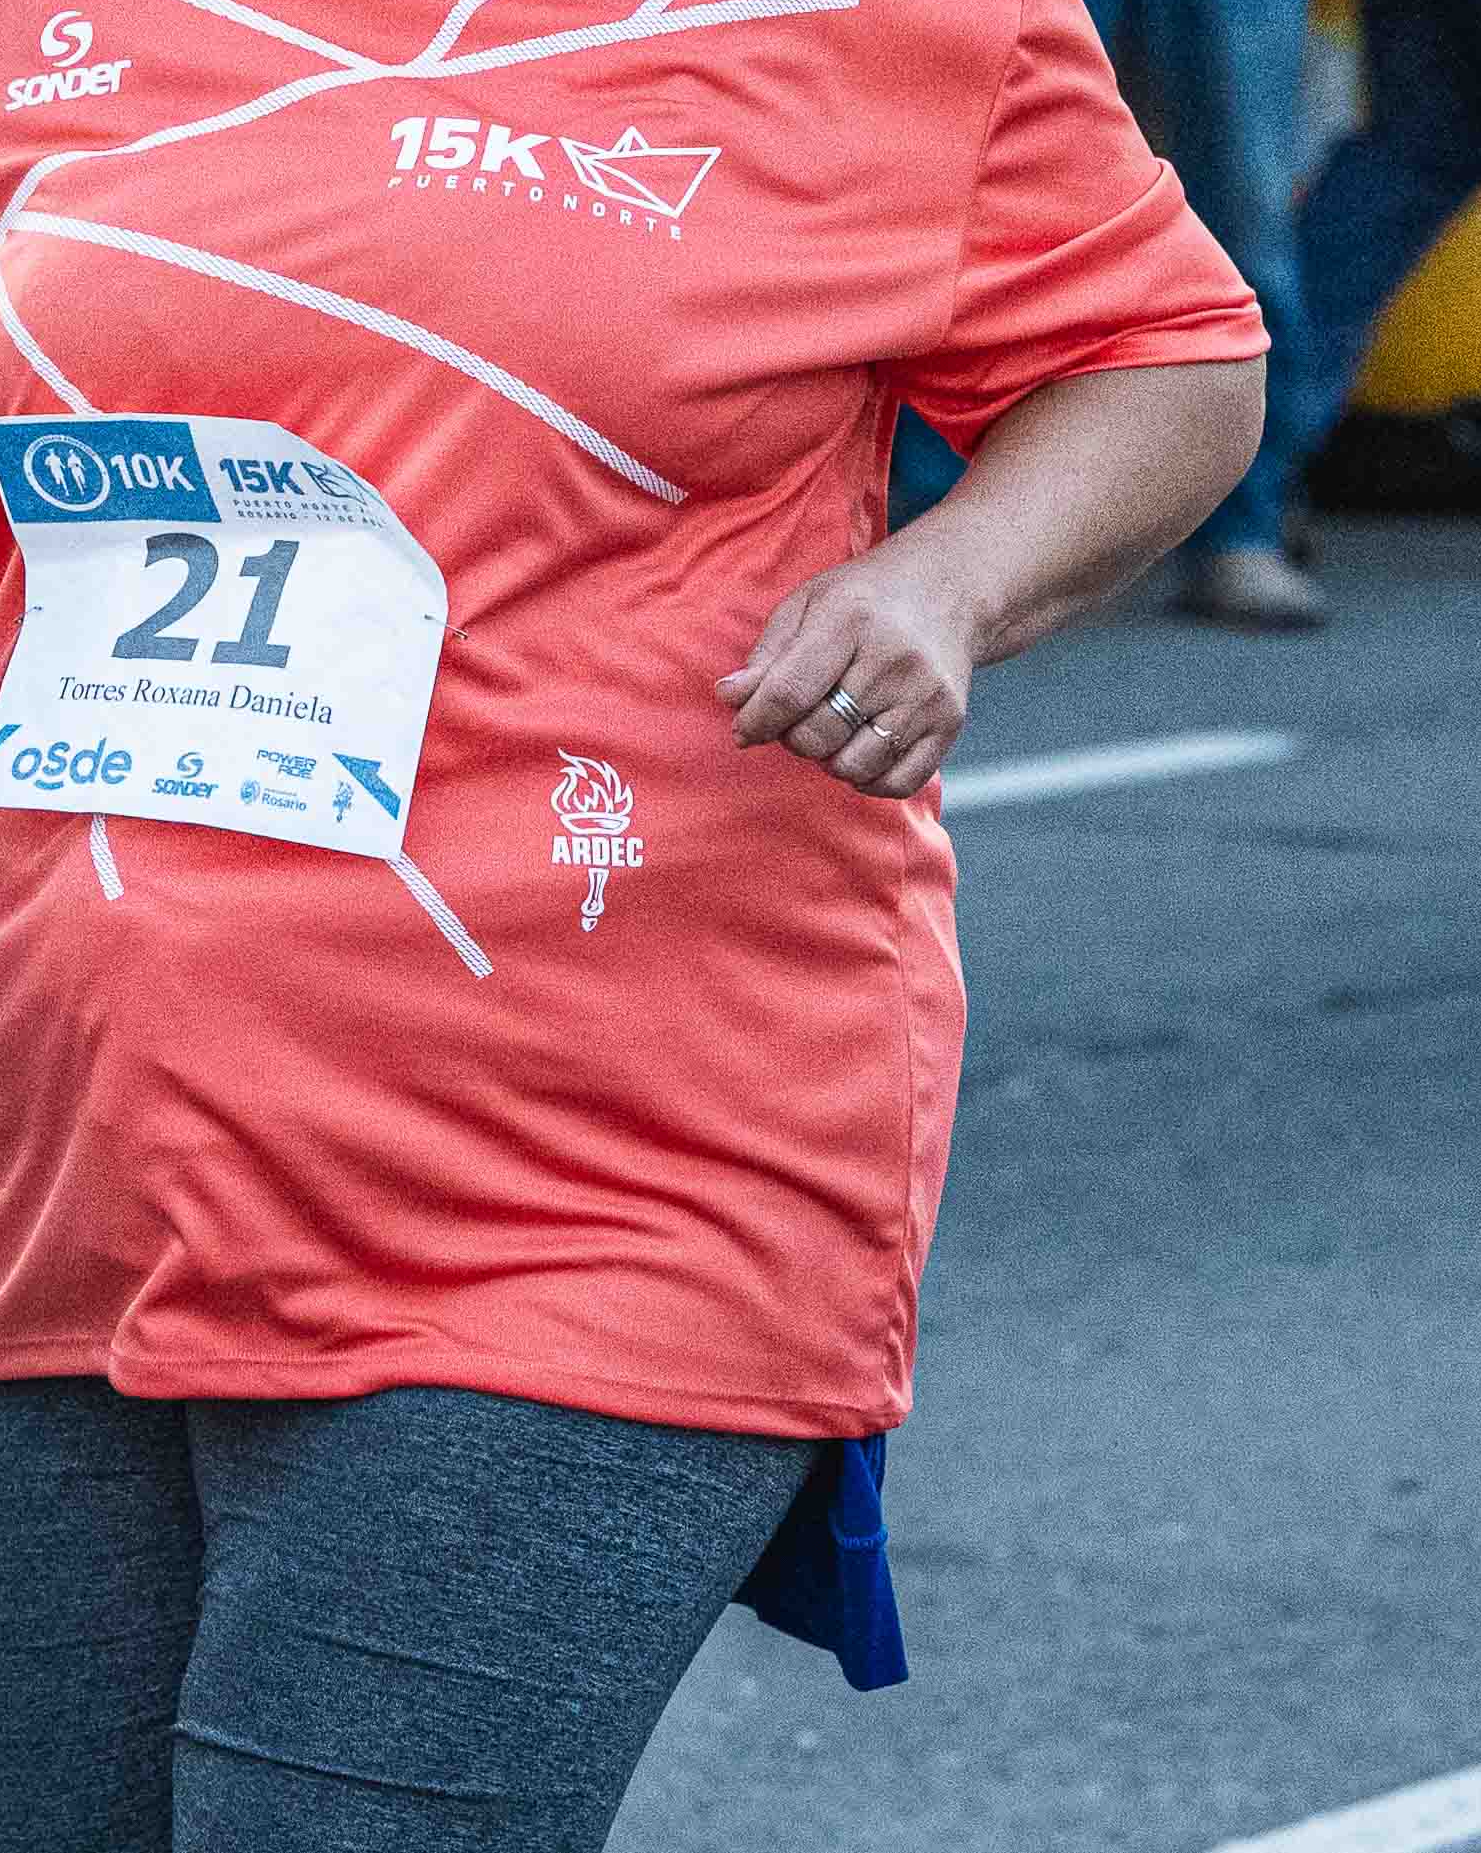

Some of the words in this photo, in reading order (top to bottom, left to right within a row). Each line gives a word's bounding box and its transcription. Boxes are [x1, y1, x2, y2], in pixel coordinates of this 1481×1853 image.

[389, 116, 552, 180] 15K
[387, 174, 544, 201] PUERTO
[563, 194, 682, 240] NORTE
[110, 453, 196, 492] 10K
[219, 457, 305, 496] 15K
[111, 532, 300, 669] 21
[58, 676, 126, 702] Torres
[132, 678, 221, 708] Roxana
[229, 684, 333, 725] Daniela
[262, 792, 307, 812] Rosario
[551, 835, 644, 868] ARDEC
